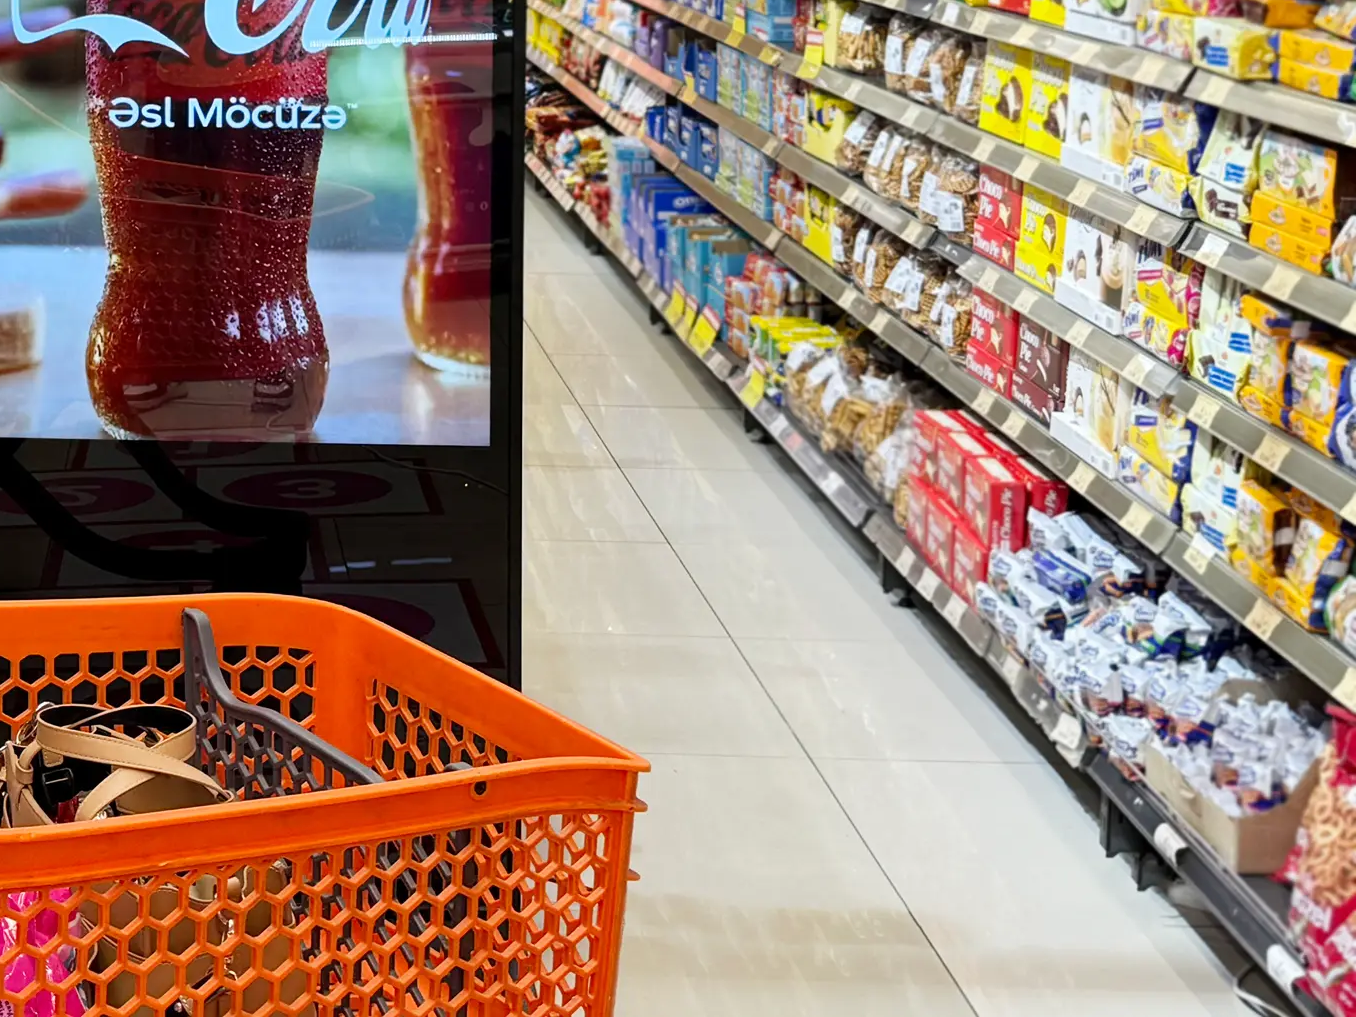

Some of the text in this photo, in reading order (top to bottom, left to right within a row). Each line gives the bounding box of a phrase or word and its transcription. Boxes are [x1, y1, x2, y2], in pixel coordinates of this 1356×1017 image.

[109, 97, 175, 129] Əsl
[187, 97, 347, 130] Möcüzə
[1000, 487, 1013, 541] Choco Pie
